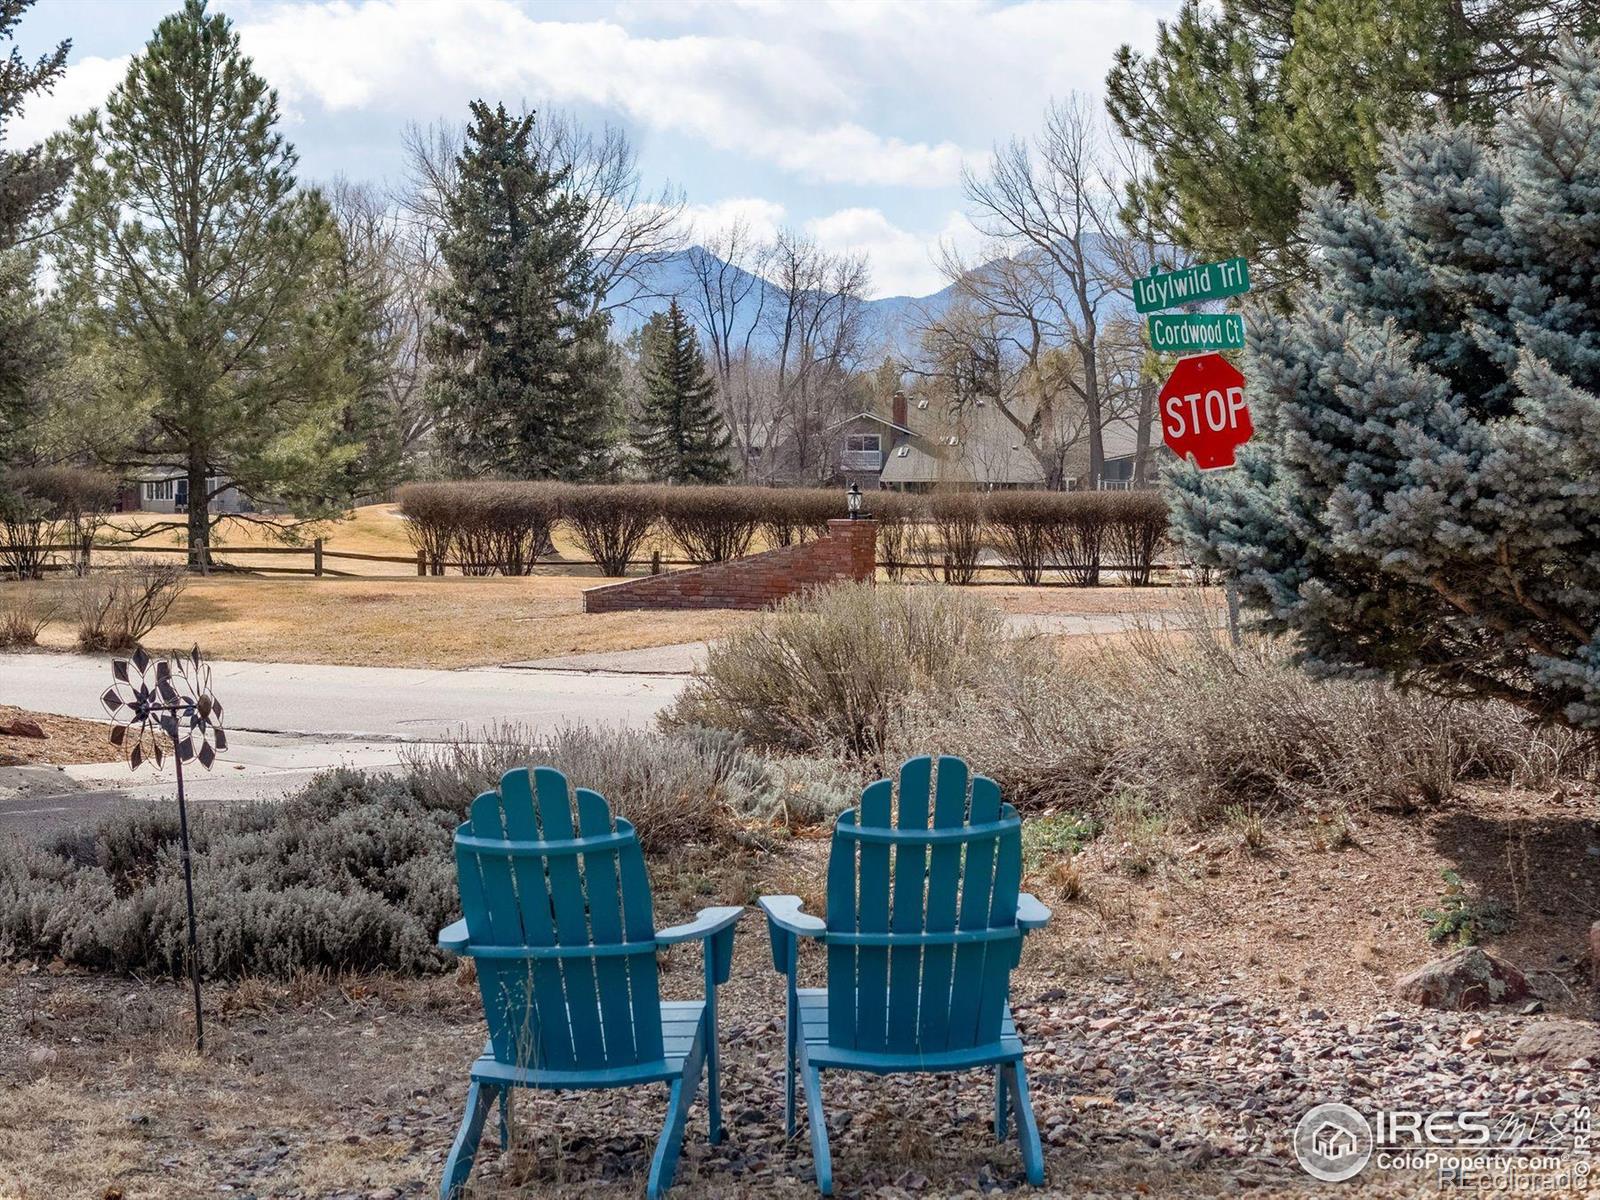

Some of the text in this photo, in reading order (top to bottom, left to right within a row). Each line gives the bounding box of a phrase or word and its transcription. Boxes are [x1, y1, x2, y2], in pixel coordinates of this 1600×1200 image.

[1138, 260, 1243, 308] Idylwild Trl
[1154, 318, 1241, 346] Cordwood Ct
[1166, 386, 1247, 438] STOP
